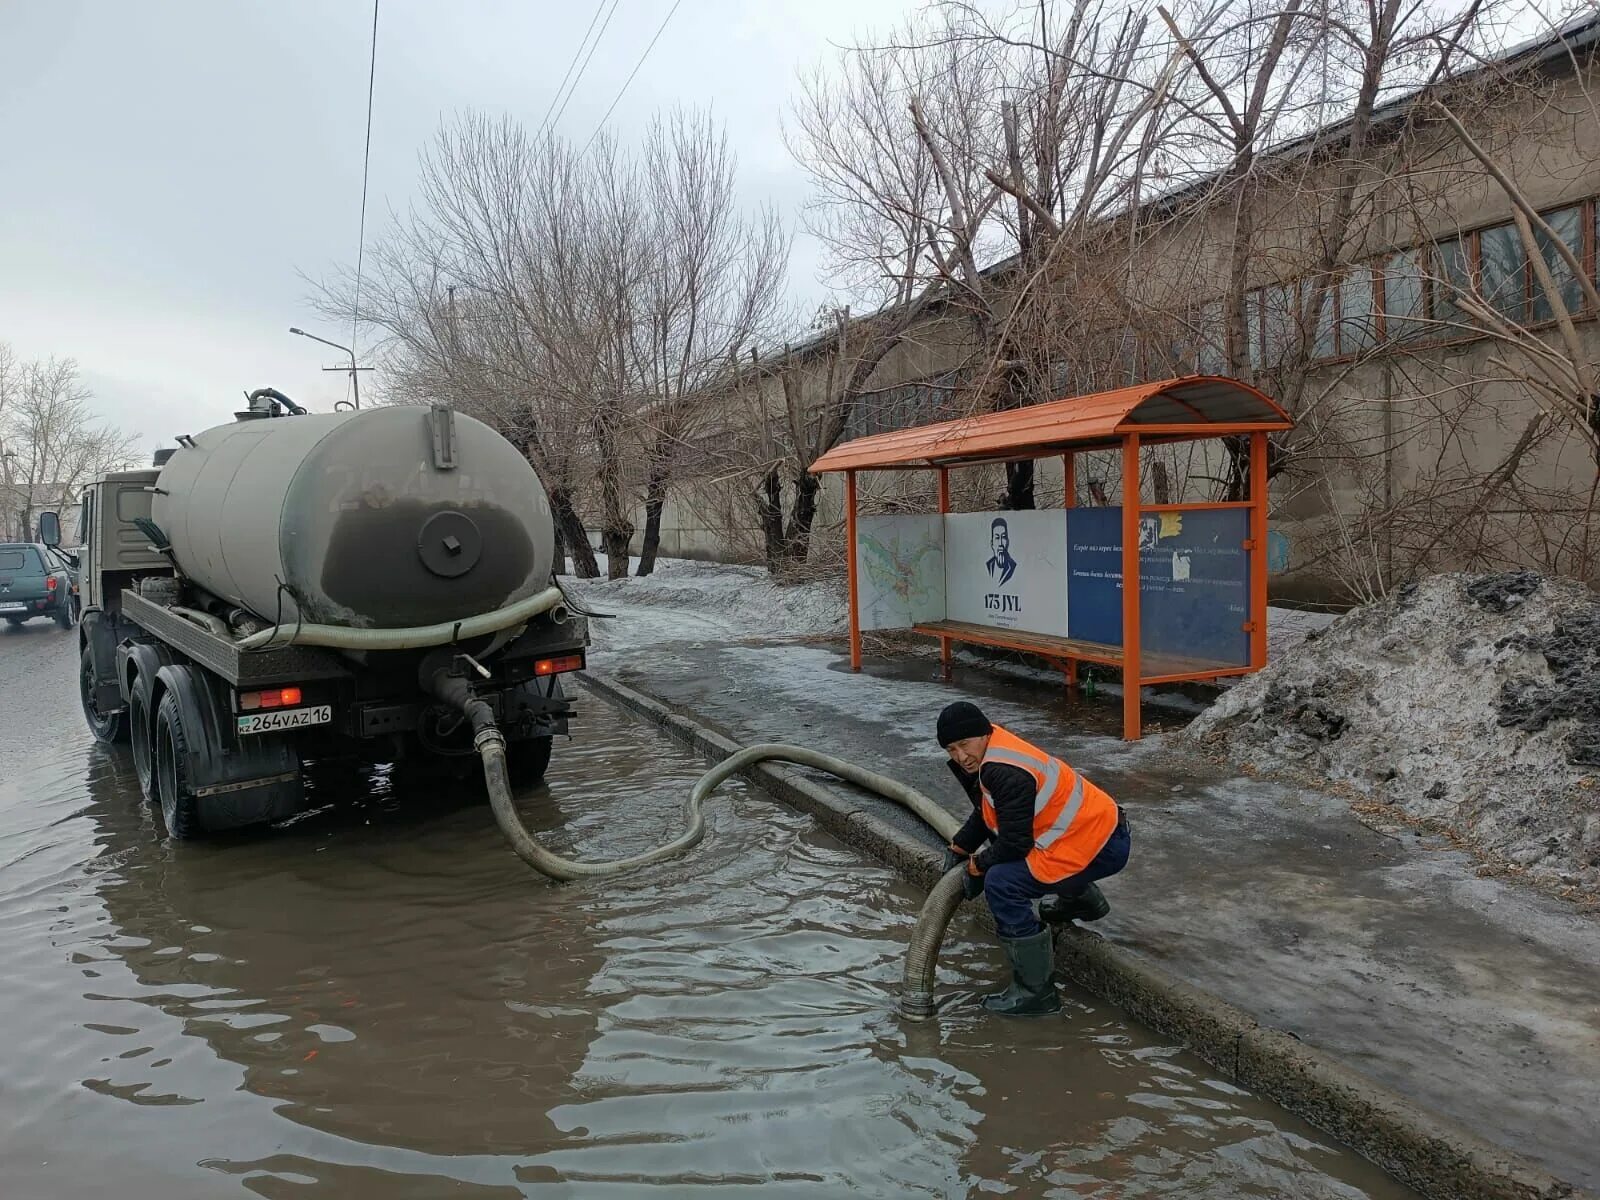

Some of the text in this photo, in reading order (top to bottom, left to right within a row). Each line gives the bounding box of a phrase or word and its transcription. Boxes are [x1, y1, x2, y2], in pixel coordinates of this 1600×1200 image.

[984, 593, 1022, 612] 175 JYL
[313, 707, 330, 722] 16
[238, 725, 250, 733] KZ
